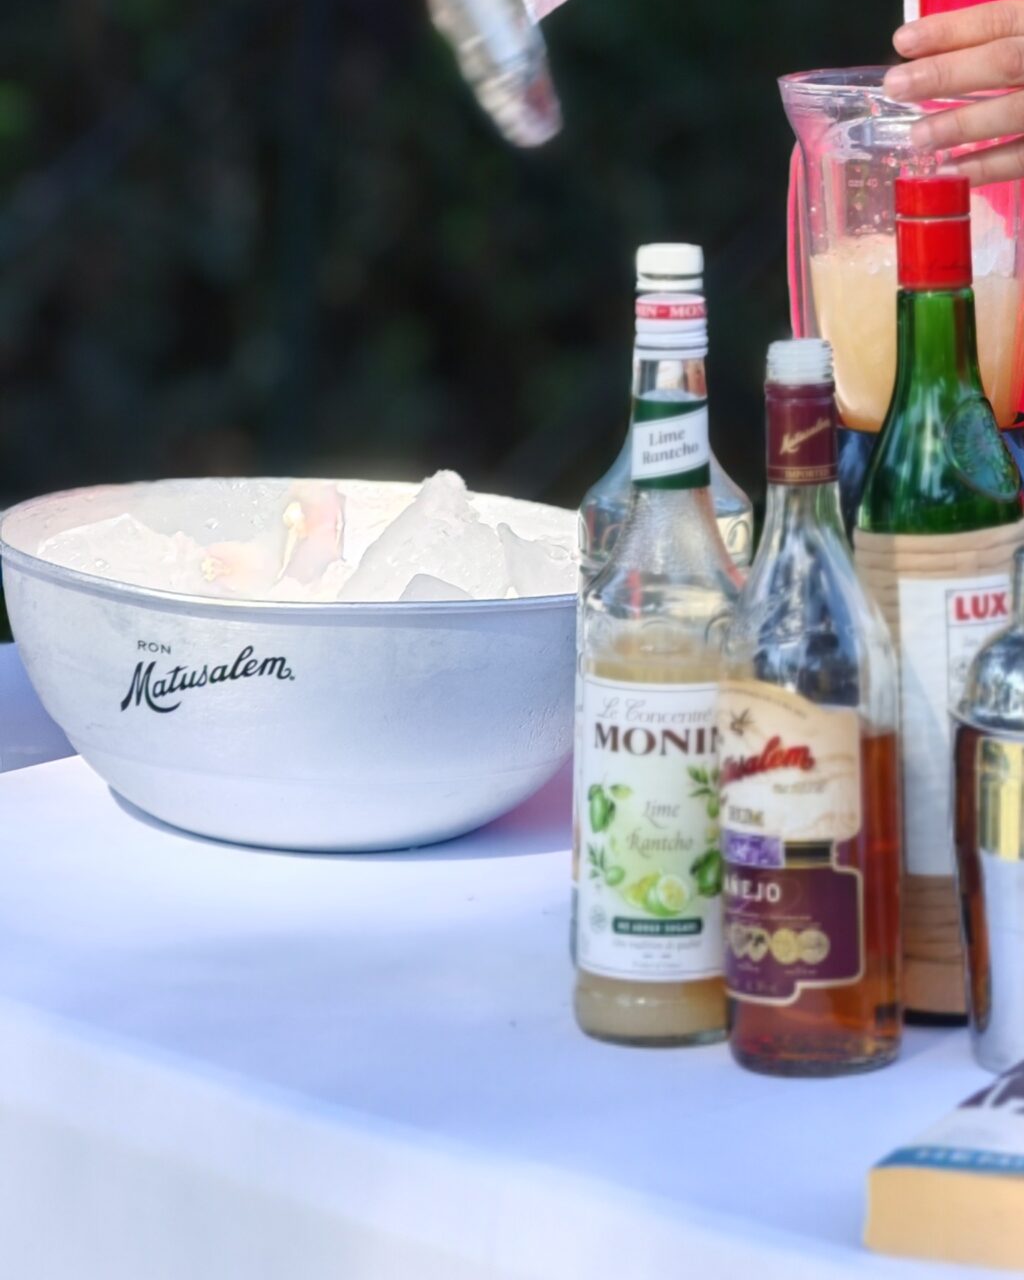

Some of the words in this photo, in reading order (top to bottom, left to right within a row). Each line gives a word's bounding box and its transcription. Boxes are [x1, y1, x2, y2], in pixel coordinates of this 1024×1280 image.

[649, 429, 686, 447] Lime
[642, 442, 699, 465] Rantcho
[137, 639, 171, 655] RON
[641, 799, 682, 830] Lime
